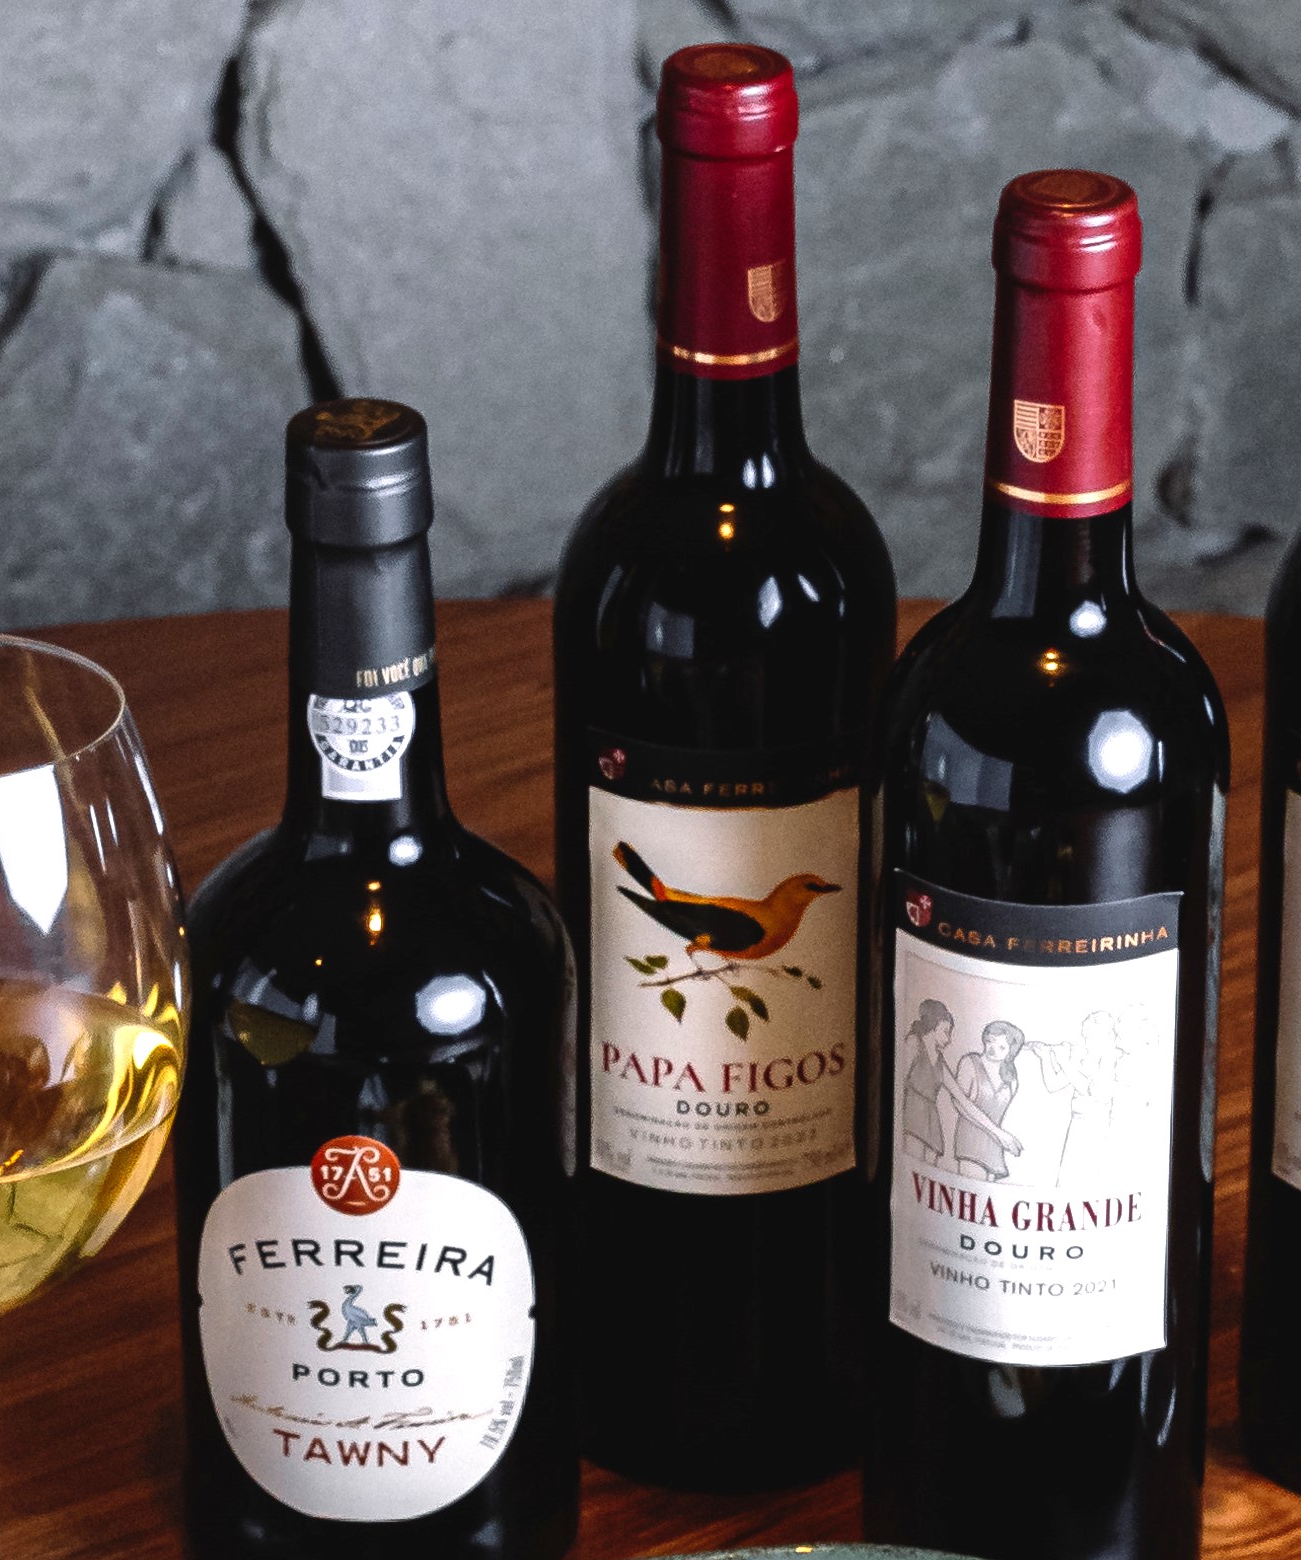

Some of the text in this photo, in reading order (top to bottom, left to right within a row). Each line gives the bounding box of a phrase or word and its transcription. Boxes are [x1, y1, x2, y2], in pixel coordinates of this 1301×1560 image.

[938, 922, 1169, 954] CASA FERREIRINHA
[602, 1041, 846, 1096] PAPA FIGOS
[676, 1100, 770, 1118] DOURO
[911, 1171, 1142, 1234] VINHA GRANDE
[229, 1239, 496, 1287] FERREIRA
[959, 1234, 1084, 1261] DOURO
[930, 1261, 990, 1292] VINHO
[999, 1279, 1064, 1297] TINTO
[1073, 1279, 1117, 1296] 2021
[292, 1363, 424, 1388] PORTO
[273, 1428, 446, 1467] TAWNY
